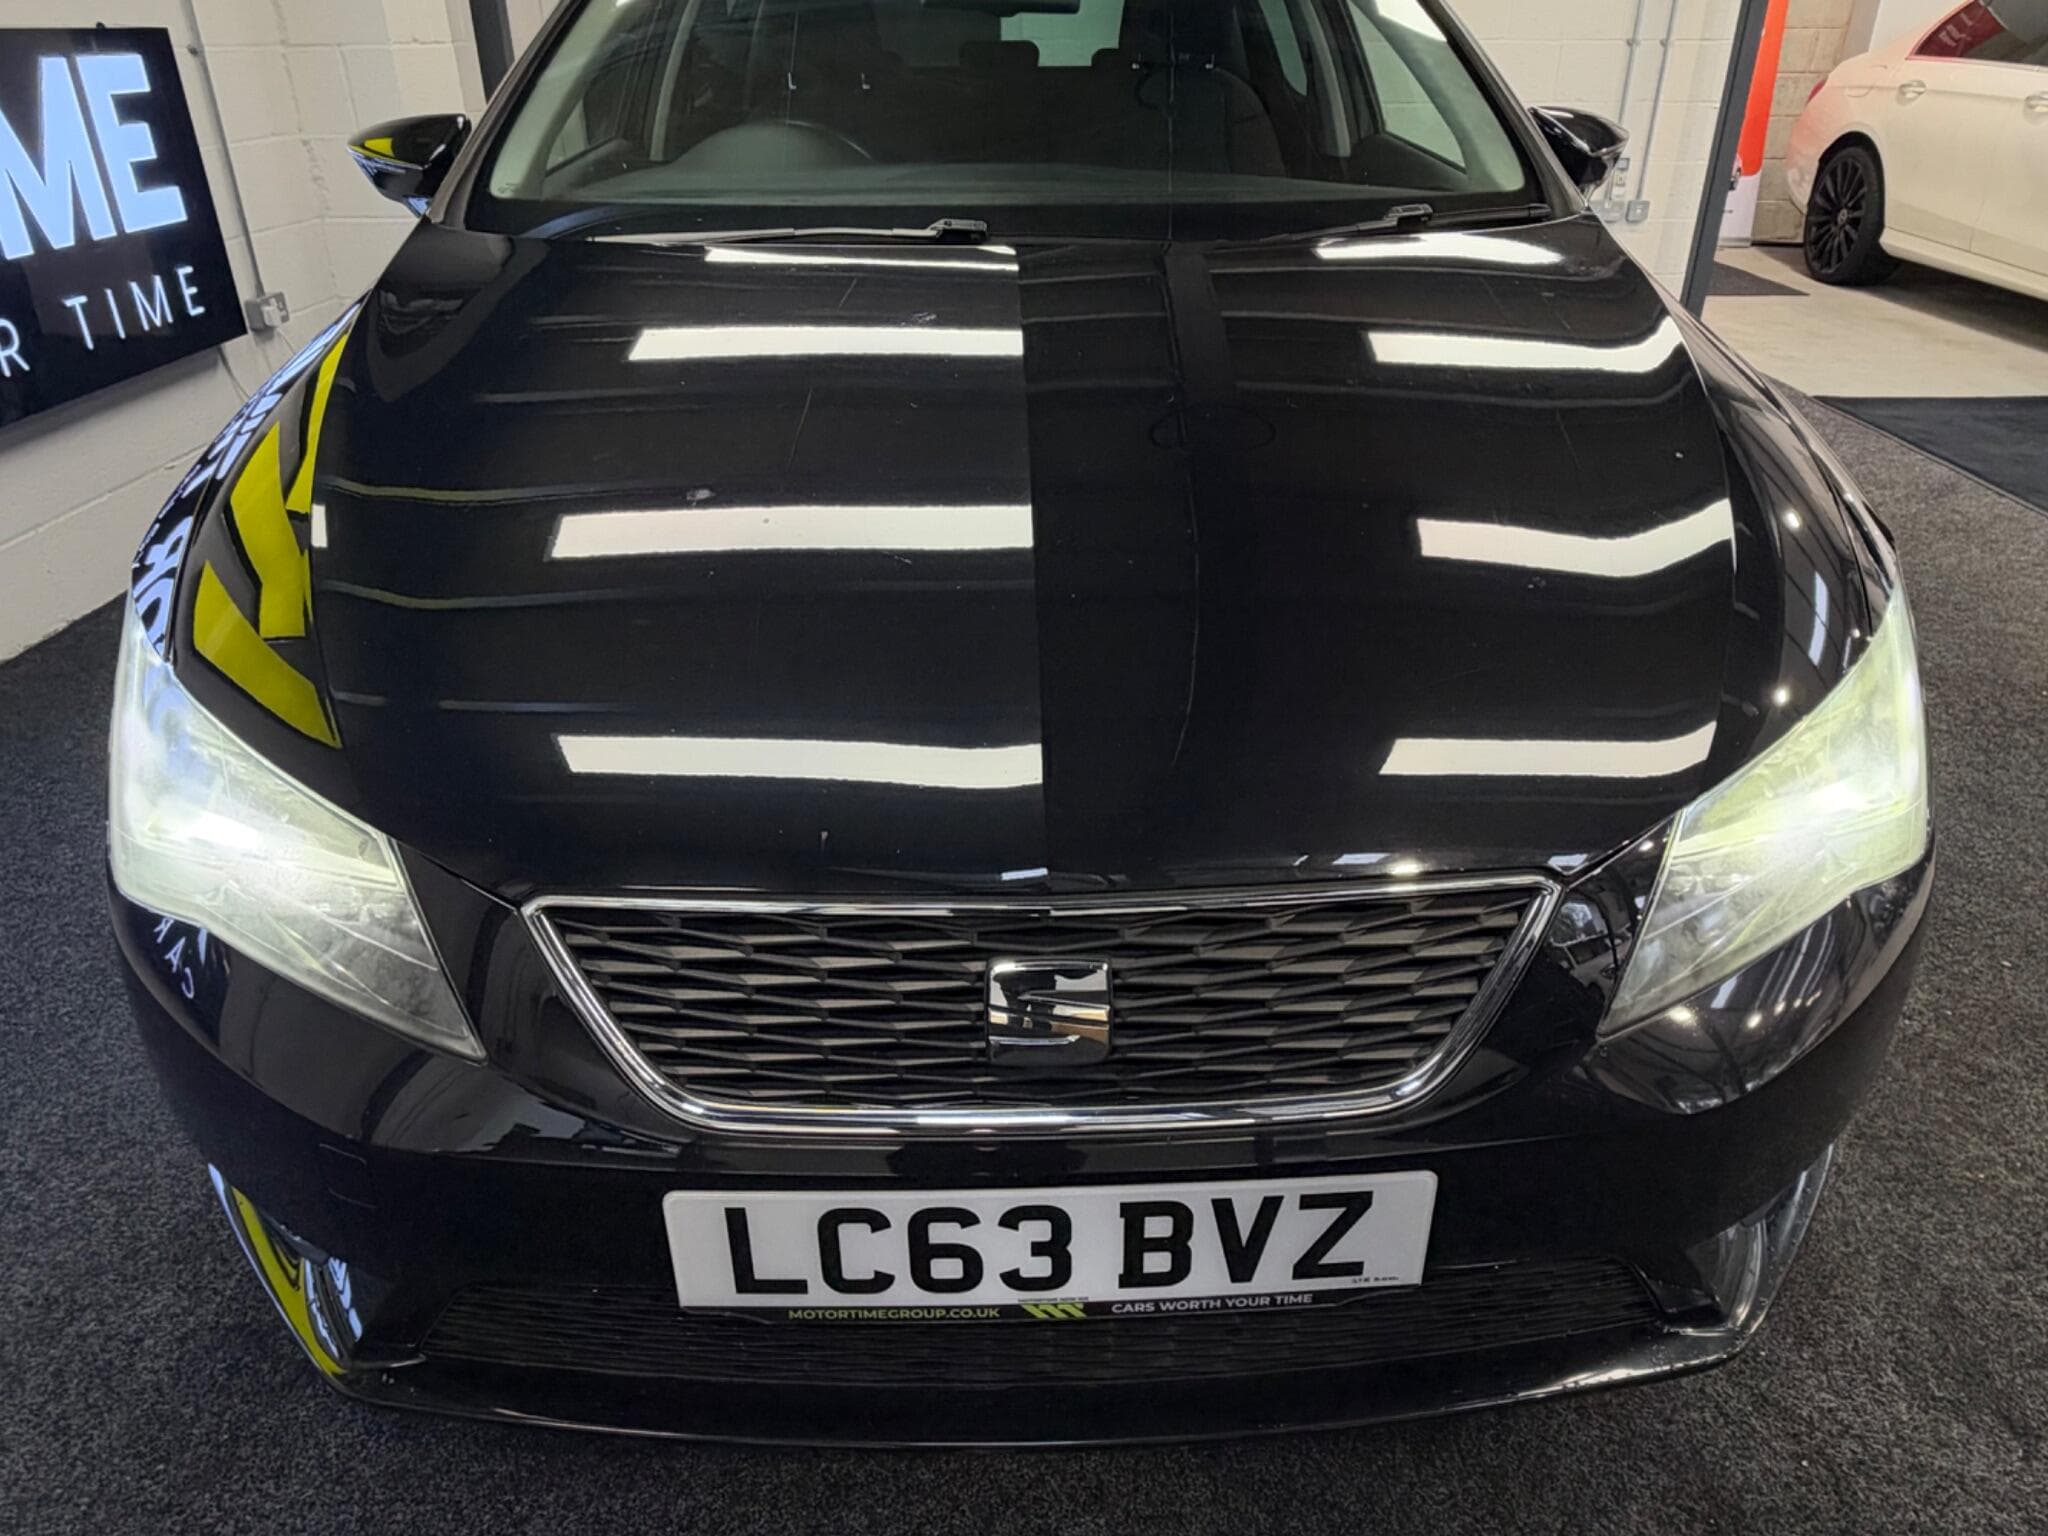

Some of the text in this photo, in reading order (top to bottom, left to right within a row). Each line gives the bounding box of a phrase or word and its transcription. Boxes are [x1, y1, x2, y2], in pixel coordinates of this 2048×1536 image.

[63, 265, 206, 351] TIME
[725, 1191, 1373, 1294] LC63 BVZ
[788, 1307, 1001, 1320] MOTORTIMEGROUP.CO.UK
[1111, 1293, 1313, 1314] CARS WORTH YOUR TIME
